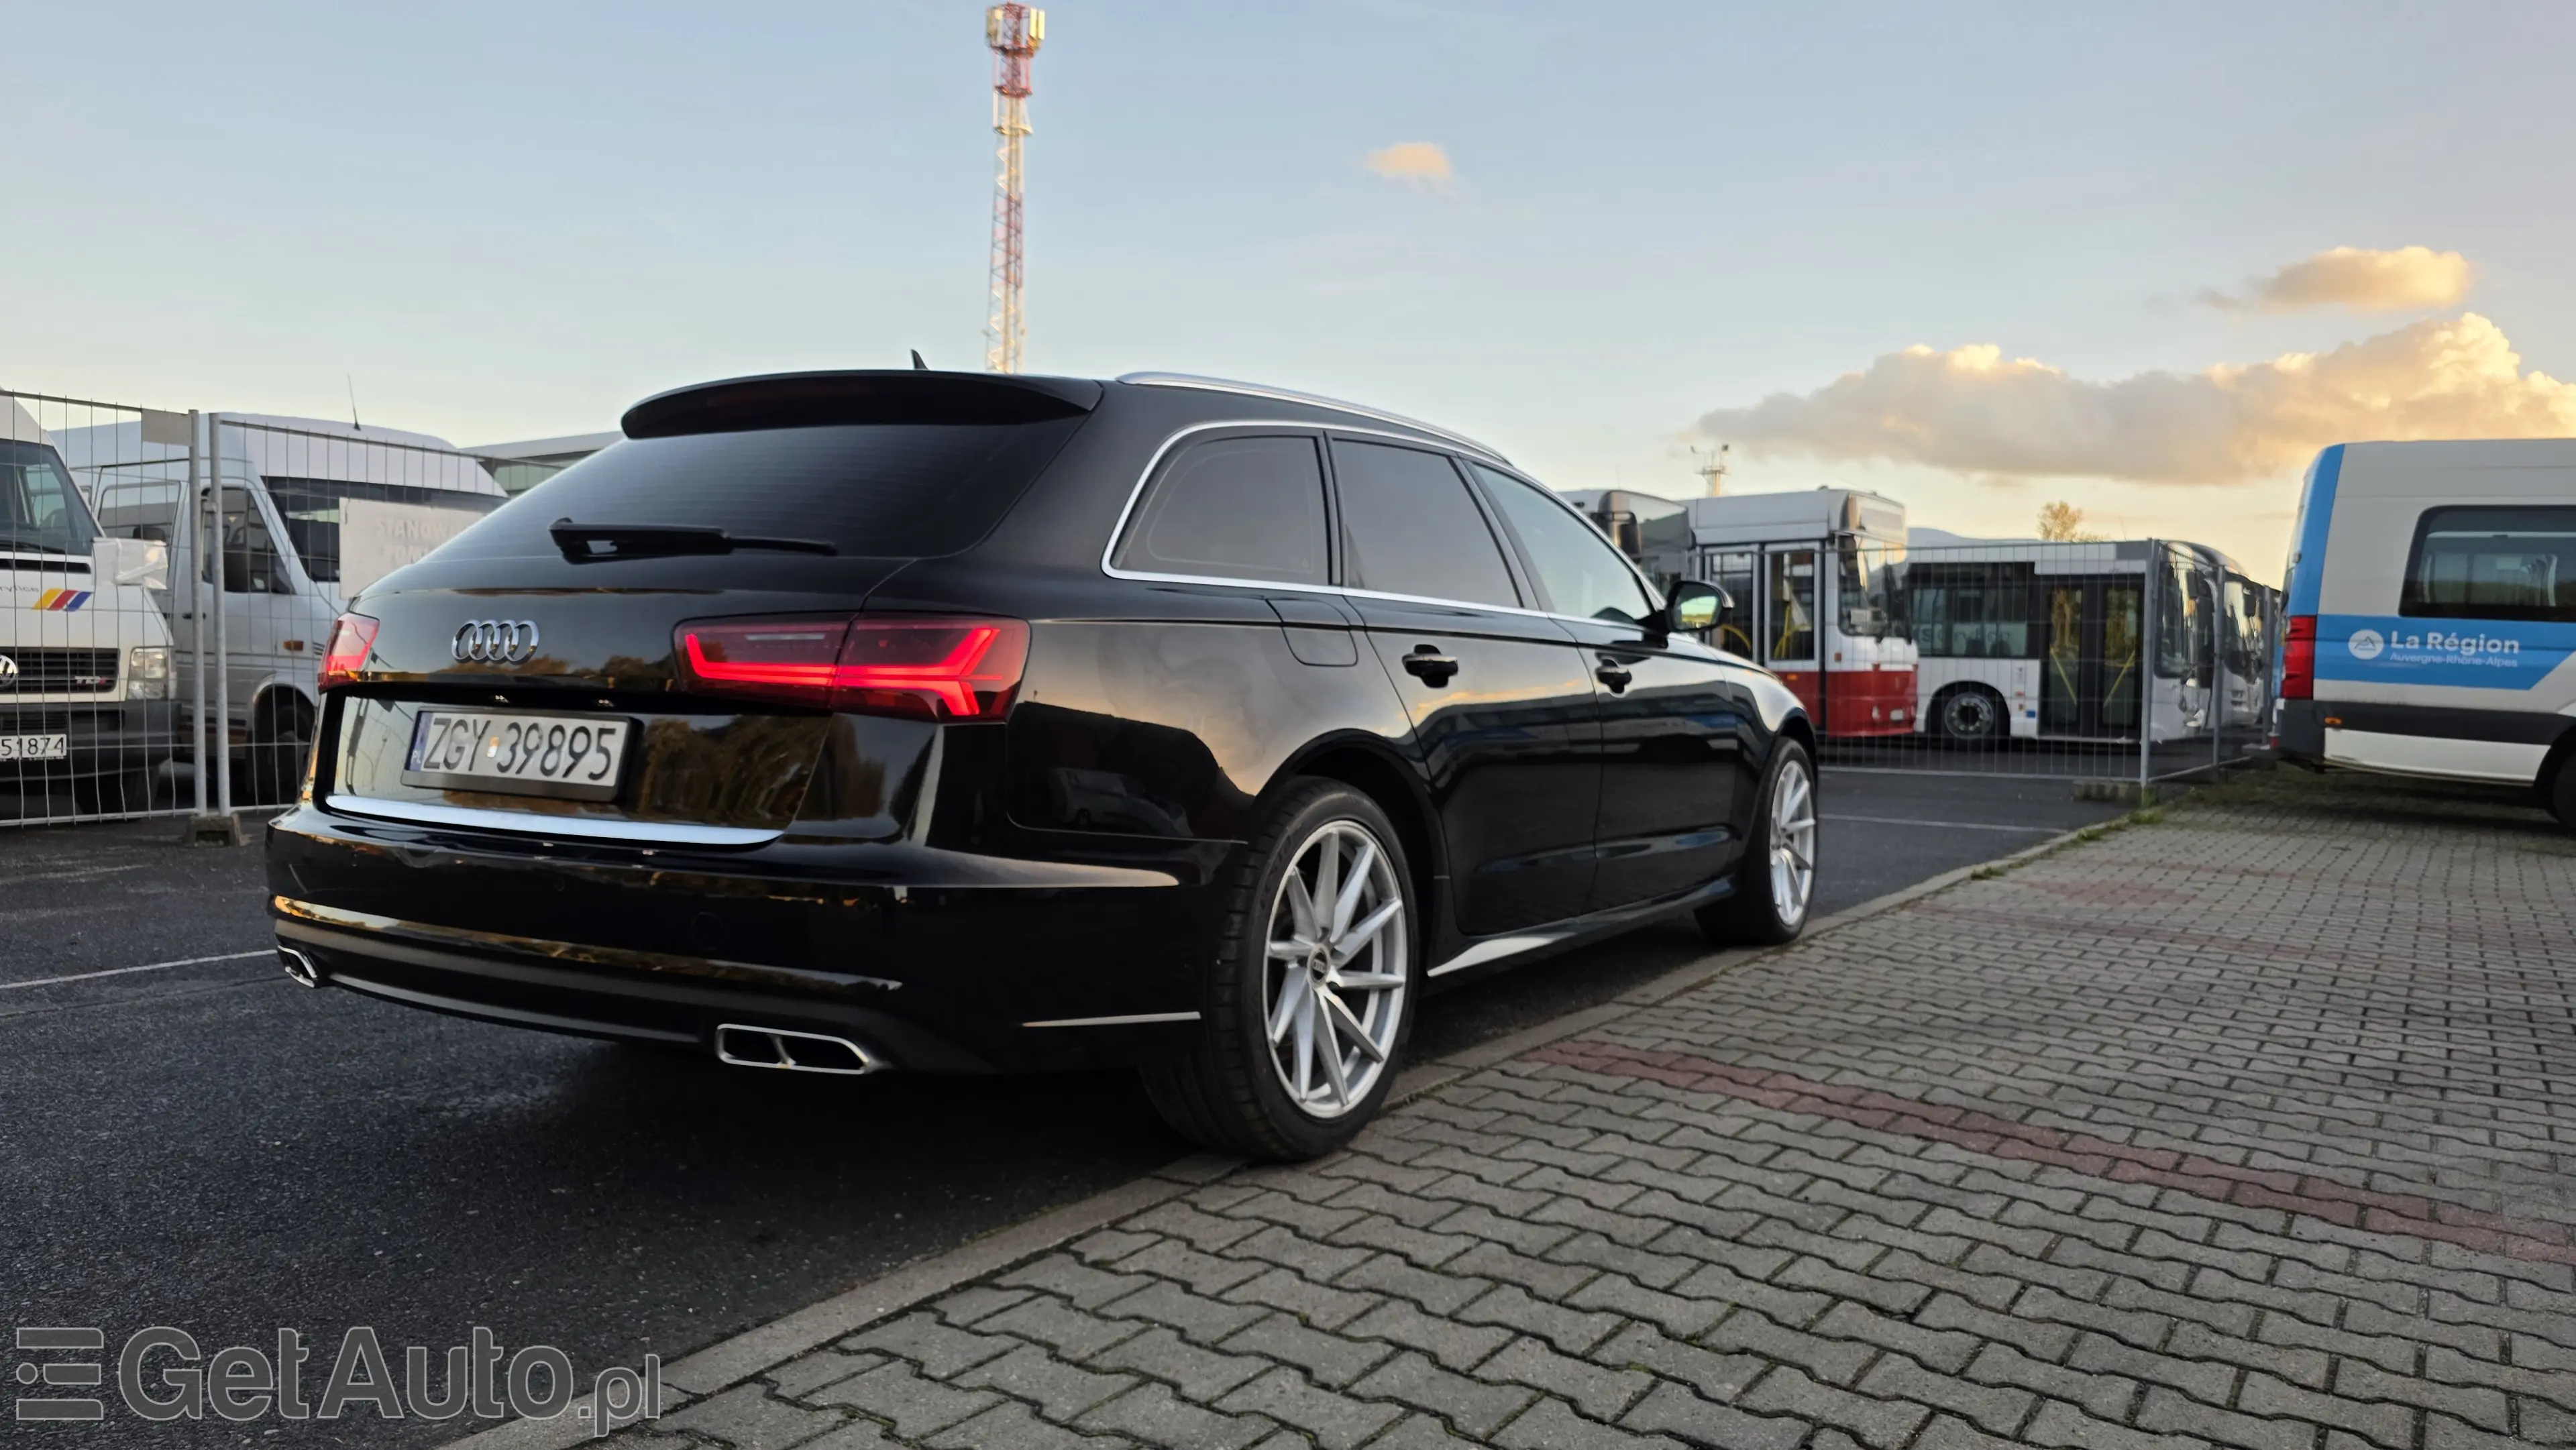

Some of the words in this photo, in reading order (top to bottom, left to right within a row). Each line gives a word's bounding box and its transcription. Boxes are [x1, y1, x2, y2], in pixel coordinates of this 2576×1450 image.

[2390, 630, 2420, 649] La
[2426, 632, 2520, 656] Région
[2390, 651, 2518, 667] Auvergne-Rhône-Alpes
[1, 737, 64, 757] 51874
[423, 717, 492, 771] ZGY
[496, 722, 616, 781] 39895
[411, 750, 422, 765] PL
